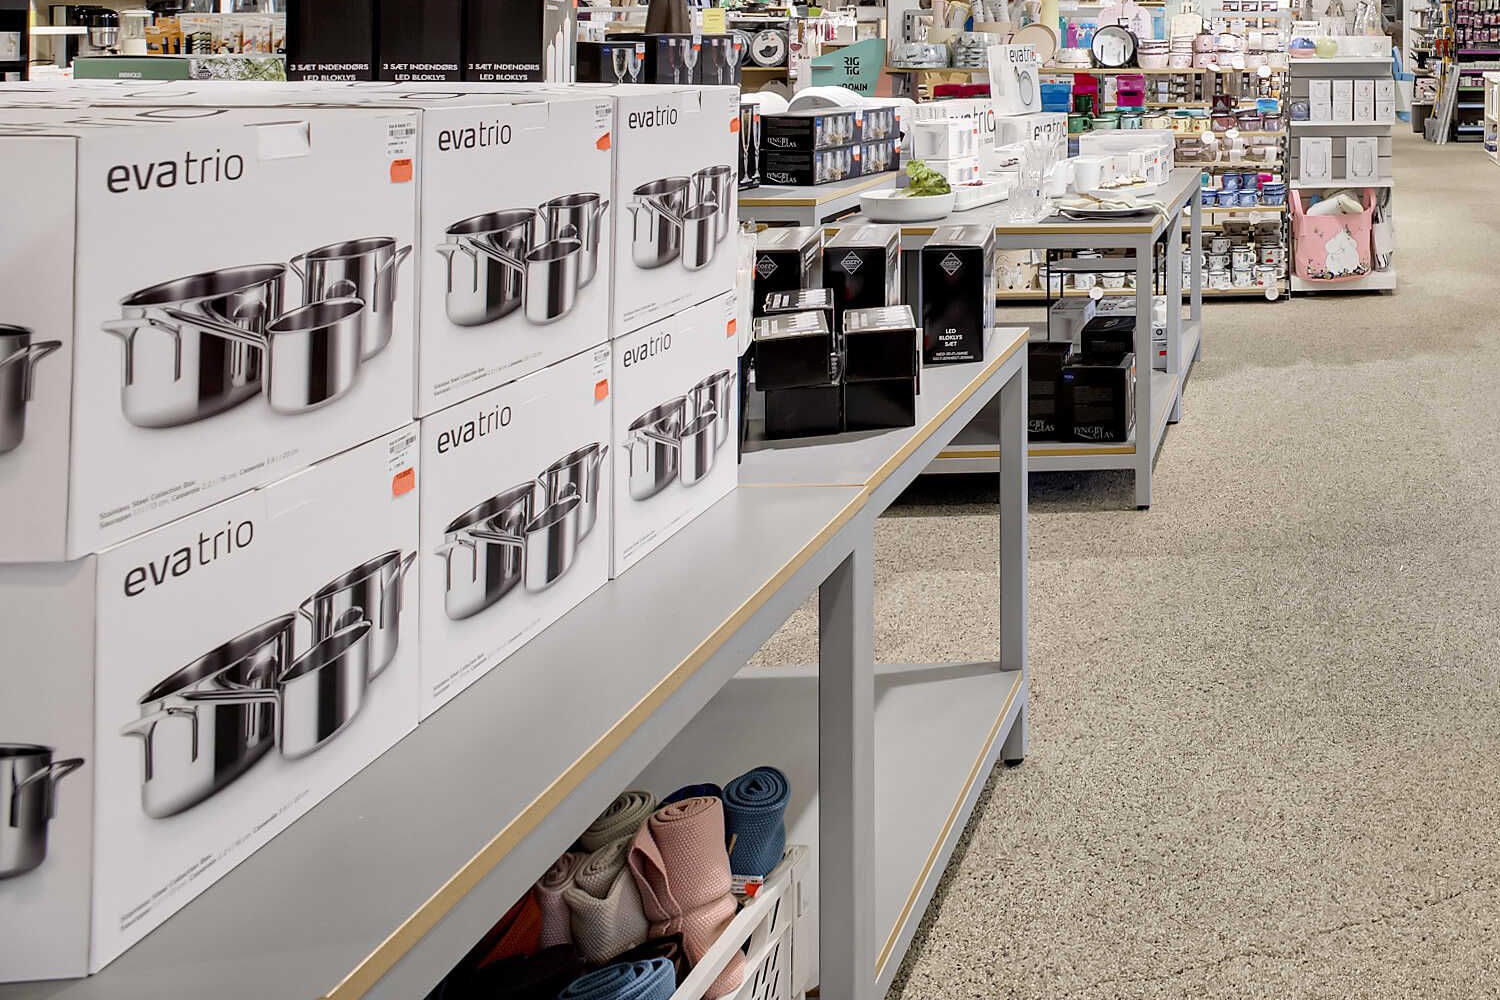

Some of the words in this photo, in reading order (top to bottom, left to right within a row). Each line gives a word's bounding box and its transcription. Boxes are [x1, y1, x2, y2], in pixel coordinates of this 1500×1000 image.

[297, 63, 317, 71] SÆT
[318, 63, 369, 71] INDENDØRS
[390, 63, 409, 71] SÆT
[409, 63, 458, 71] INDENDØRS
[493, 63, 540, 71] INDENDØRS
[843, 56, 860, 66] RIG
[841, 82, 868, 92] OOMIN
[628, 104, 678, 129] evatrio
[439, 119, 512, 152] evatrio
[107, 148, 243, 193] evatrio
[623, 330, 672, 369] evatrio
[437, 403, 512, 455] evatrio
[124, 519, 254, 597] evatrio
